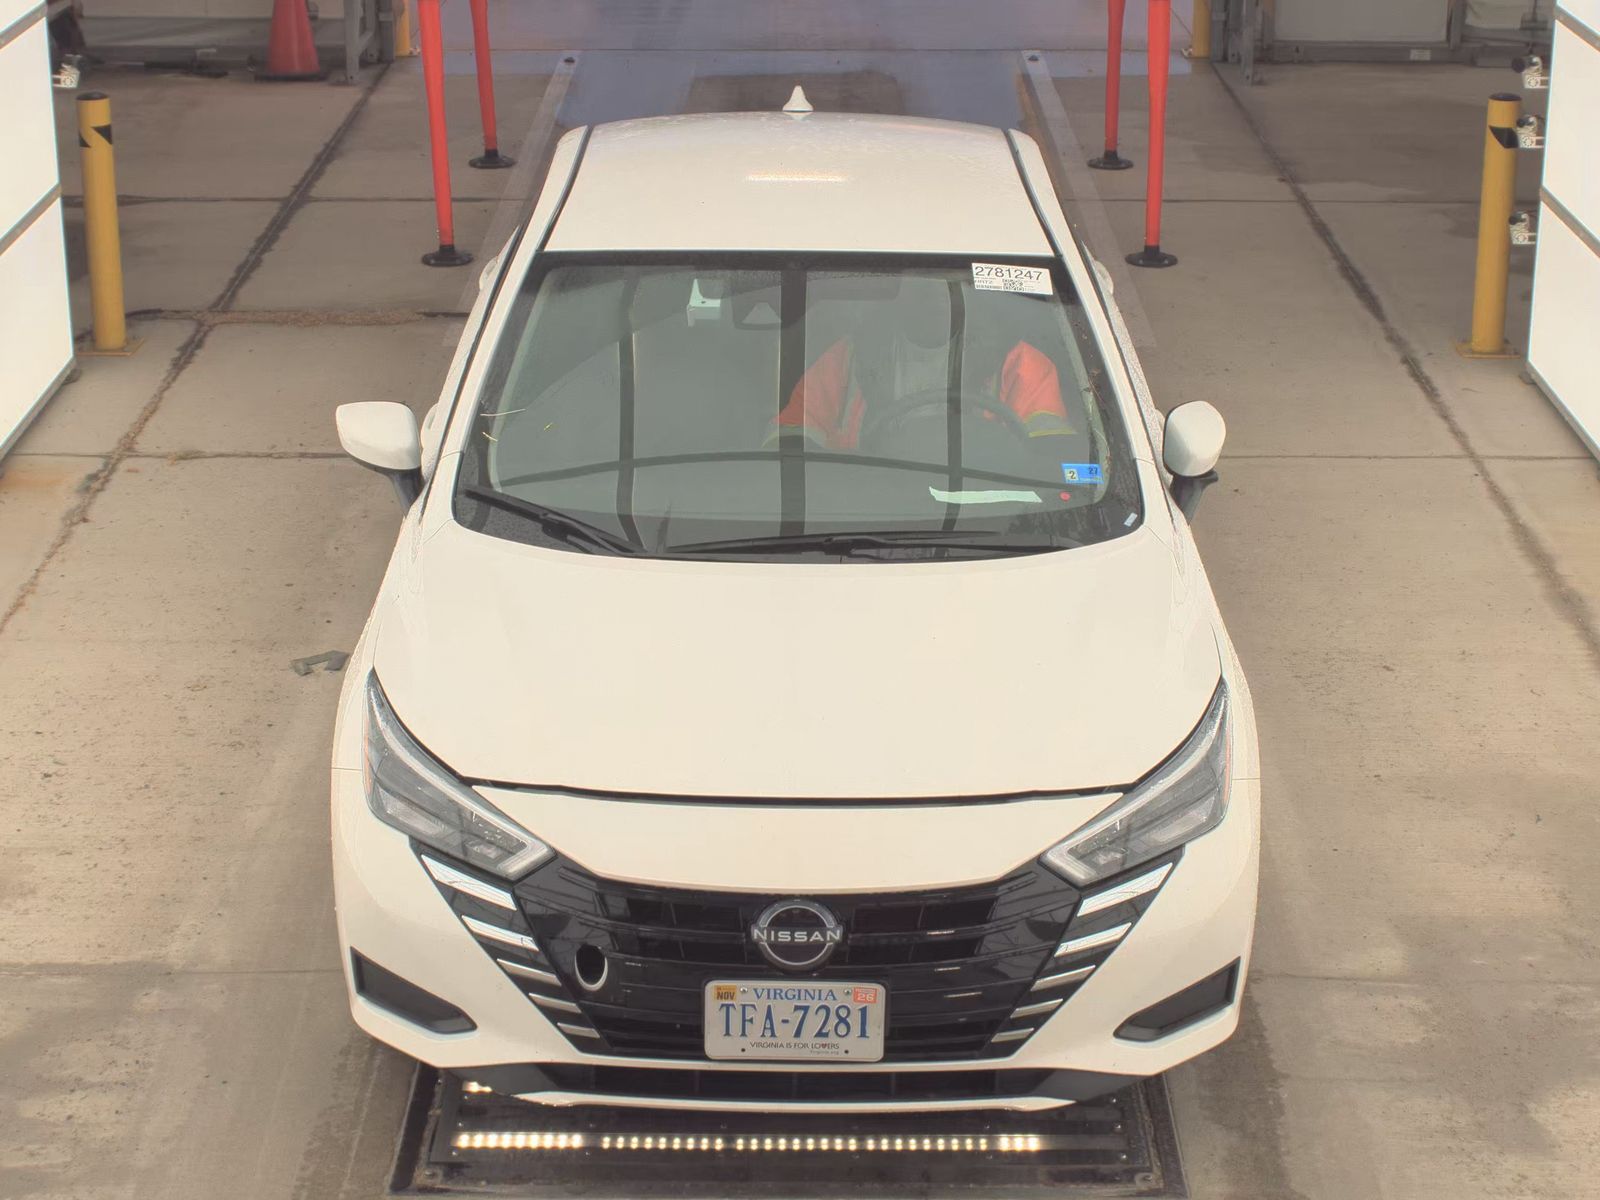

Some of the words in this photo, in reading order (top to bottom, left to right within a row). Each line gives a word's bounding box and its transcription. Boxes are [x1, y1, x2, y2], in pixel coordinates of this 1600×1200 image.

[975, 266, 1042, 280] 2781247
[1069, 470, 1076, 479] 2
[753, 929, 841, 942] NISSAN
[717, 991, 735, 1000] NOV
[753, 988, 837, 1001] VIRGINIA
[857, 993, 874, 1002] 26
[719, 1003, 870, 1038] TFA-7281
